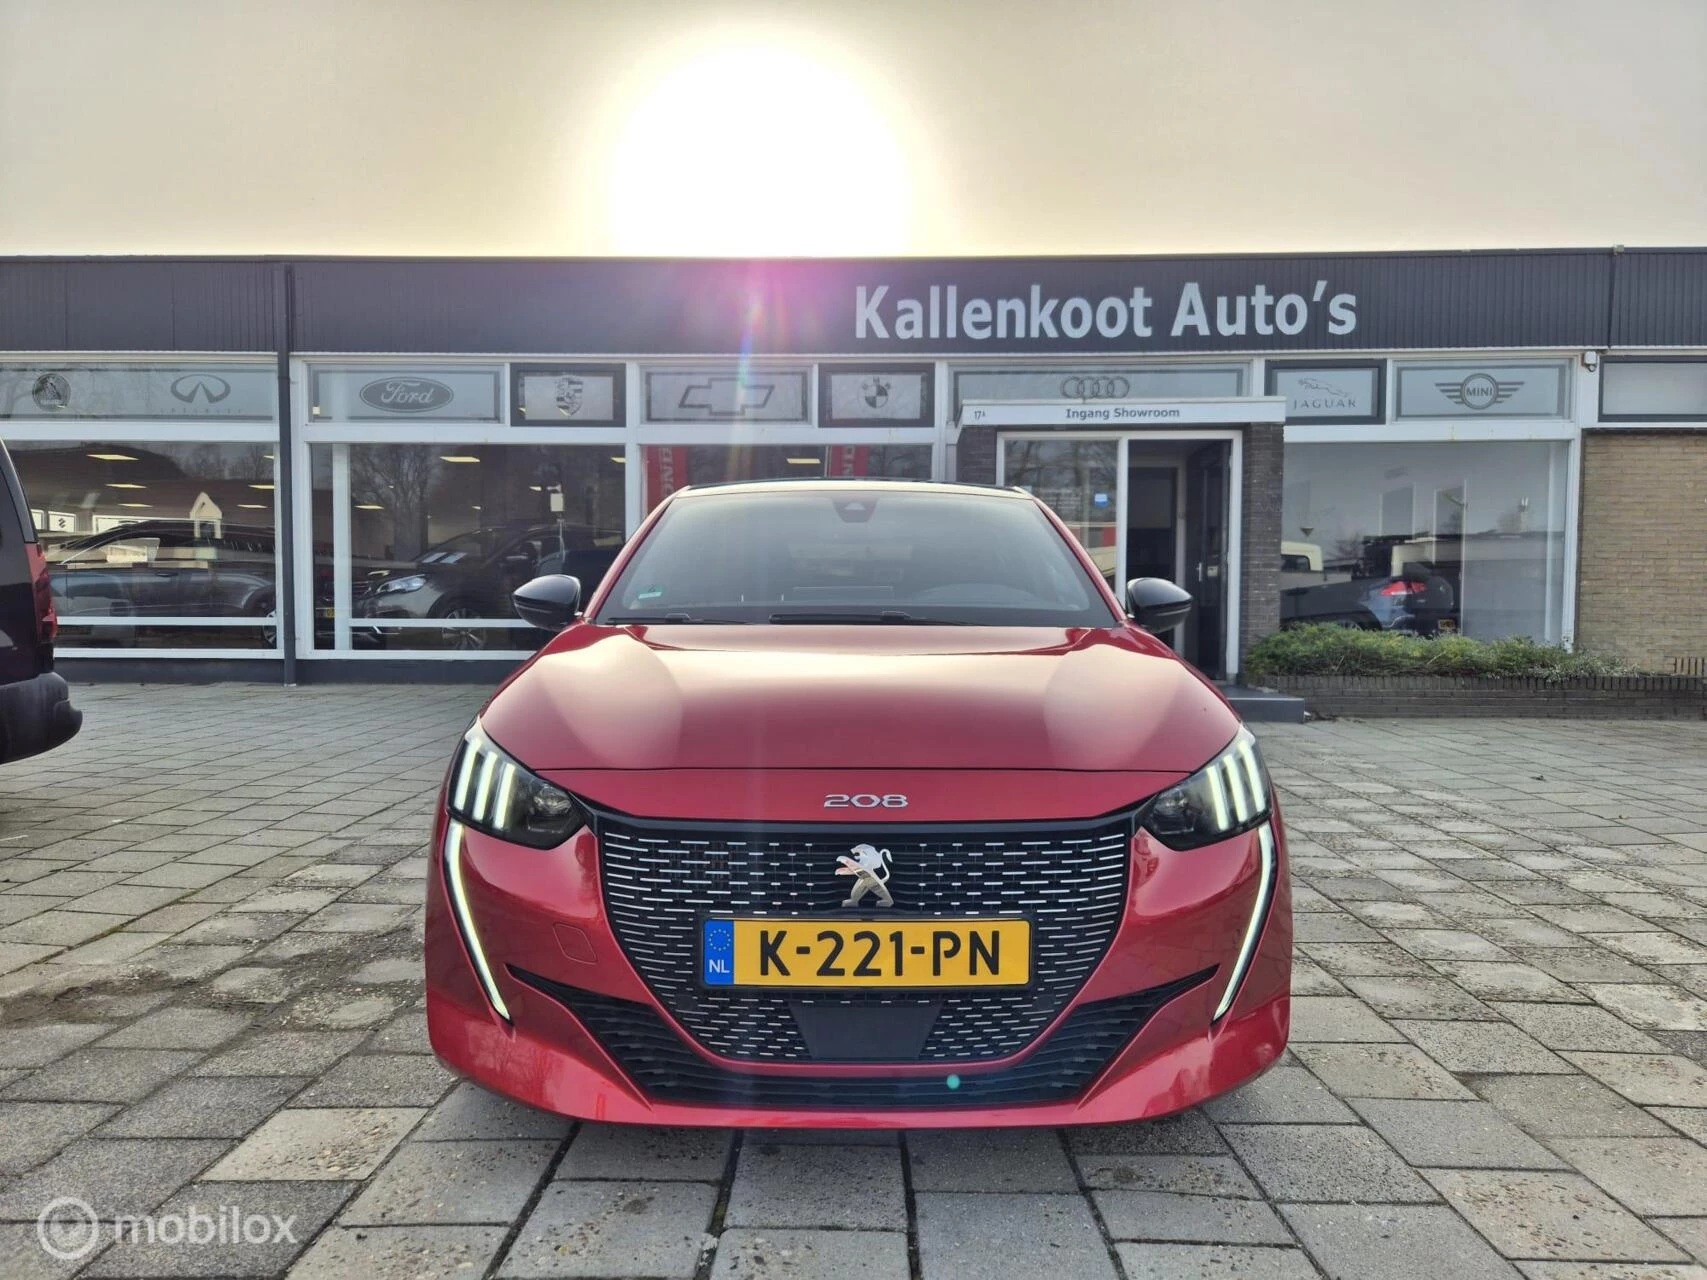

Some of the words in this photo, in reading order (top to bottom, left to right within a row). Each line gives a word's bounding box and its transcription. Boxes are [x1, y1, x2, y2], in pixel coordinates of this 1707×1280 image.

[855, 284, 1153, 339] Kallenkoot
[1170, 280, 1358, 336] Auto's
[380, 381, 434, 403] Ford
[1466, 387, 1493, 397] MINI
[1293, 399, 1357, 410] JAGUAR
[1066, 407, 1110, 420] Ingang
[1113, 407, 1180, 418] Showroom
[823, 794, 909, 808] 208
[760, 930, 1000, 977] K-221-PN
[708, 959, 730, 974] NL
